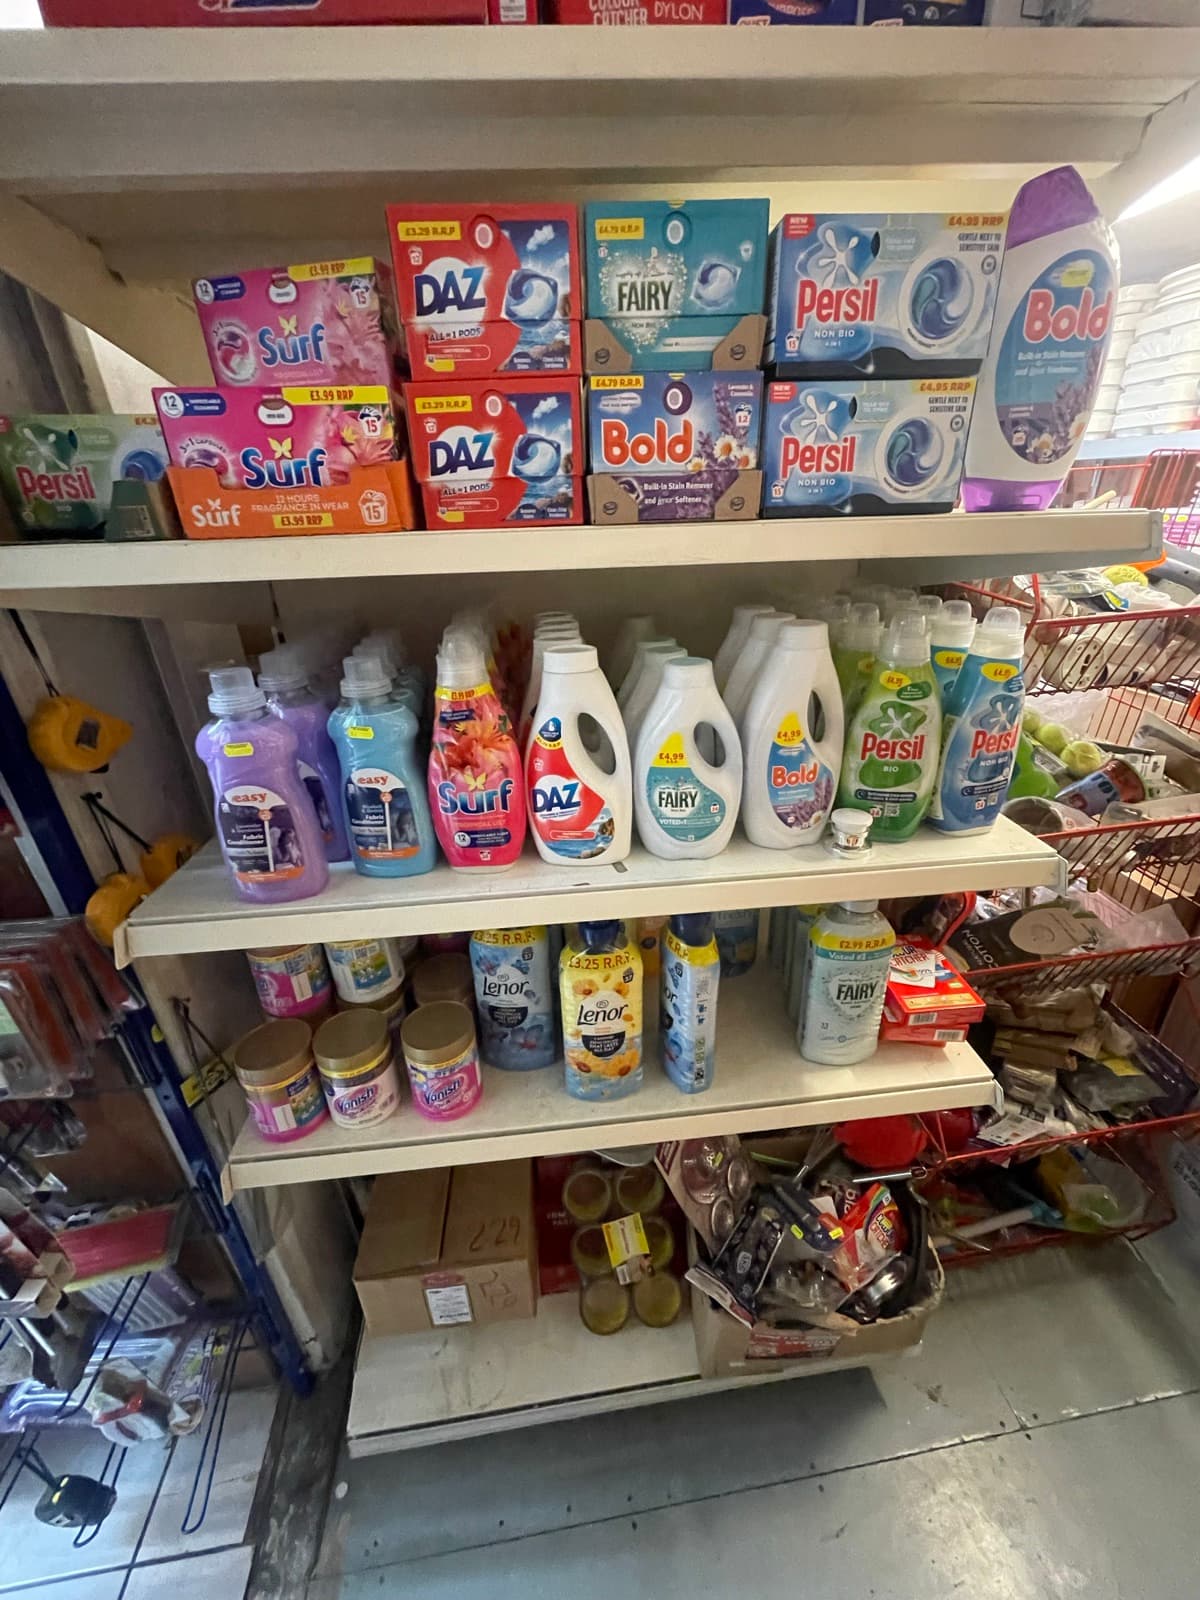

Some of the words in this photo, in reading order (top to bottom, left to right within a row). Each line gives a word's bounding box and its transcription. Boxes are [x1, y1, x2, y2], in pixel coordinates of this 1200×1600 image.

[594, 8, 648, 25] CATCHER
[654, 1, 705, 21] DYLON
[981, 216, 1003, 225] RRP
[309, 263, 330, 276] £3.99
[331, 262, 346, 274] RRP
[199, 282, 212, 297] 12
[355, 289, 367, 305] 15
[413, 266, 486, 317] DAZ
[616, 279, 673, 312] FAIRY
[796, 278, 879, 329] Persil
[1023, 286, 1112, 344] Bold
[429, 333, 444, 342] ALL
[458, 327, 481, 338] PODS
[813, 329, 837, 338] NON
[838, 328, 855, 337] BIO
[258, 322, 326, 367] Surf
[788, 341, 797, 350] 15
[309, 390, 334, 401] £3.99
[335, 389, 354, 401] RRP
[919, 383, 948, 392] £4.95
[949, 383, 970, 391] RRP
[163, 394, 176, 408] 12
[366, 418, 378, 433] 15
[738, 415, 748, 423] 12
[601, 417, 695, 466] Bold
[429, 432, 495, 477] DAZ
[780, 436, 856, 479] Persil
[239, 447, 328, 489] Surf
[15, 465, 97, 504] Persil
[442, 488, 457, 496] ALL
[469, 483, 490, 492] PODS
[668, 482, 685, 490] Stain
[685, 481, 713, 490] Remover
[798, 479, 818, 487] NON
[819, 478, 836, 486] BIO
[285, 493, 320, 502] HOURS
[644, 496, 657, 505] and
[191, 502, 241, 527] Surf
[250, 503, 309, 514] FRAGRANCE
[320, 501, 349, 511] WEAR
[365, 504, 381, 520] 15
[280, 516, 306, 526] £3.99
[306, 515, 324, 525] RRP
[776, 729, 802, 739] £4.99
[861, 731, 928, 761] Persil
[658, 752, 684, 760] £4.99
[771, 761, 820, 789] Bold
[882, 765, 899, 773] BIO
[356, 775, 389, 786] easy
[232, 791, 268, 804] easy
[437, 778, 514, 815] Surf
[531, 782, 581, 813] DAZ
[657, 790, 698, 809] FAIRY
[456, 833, 466, 841] 12
[568, 954, 601, 970] £3.25
[482, 975, 530, 997] Lenor
[836, 980, 878, 1001] FAIRY
[576, 1003, 629, 1026] Lenor
[337, 1086, 375, 1112] Vanish
[423, 1079, 461, 1106] Vanish
